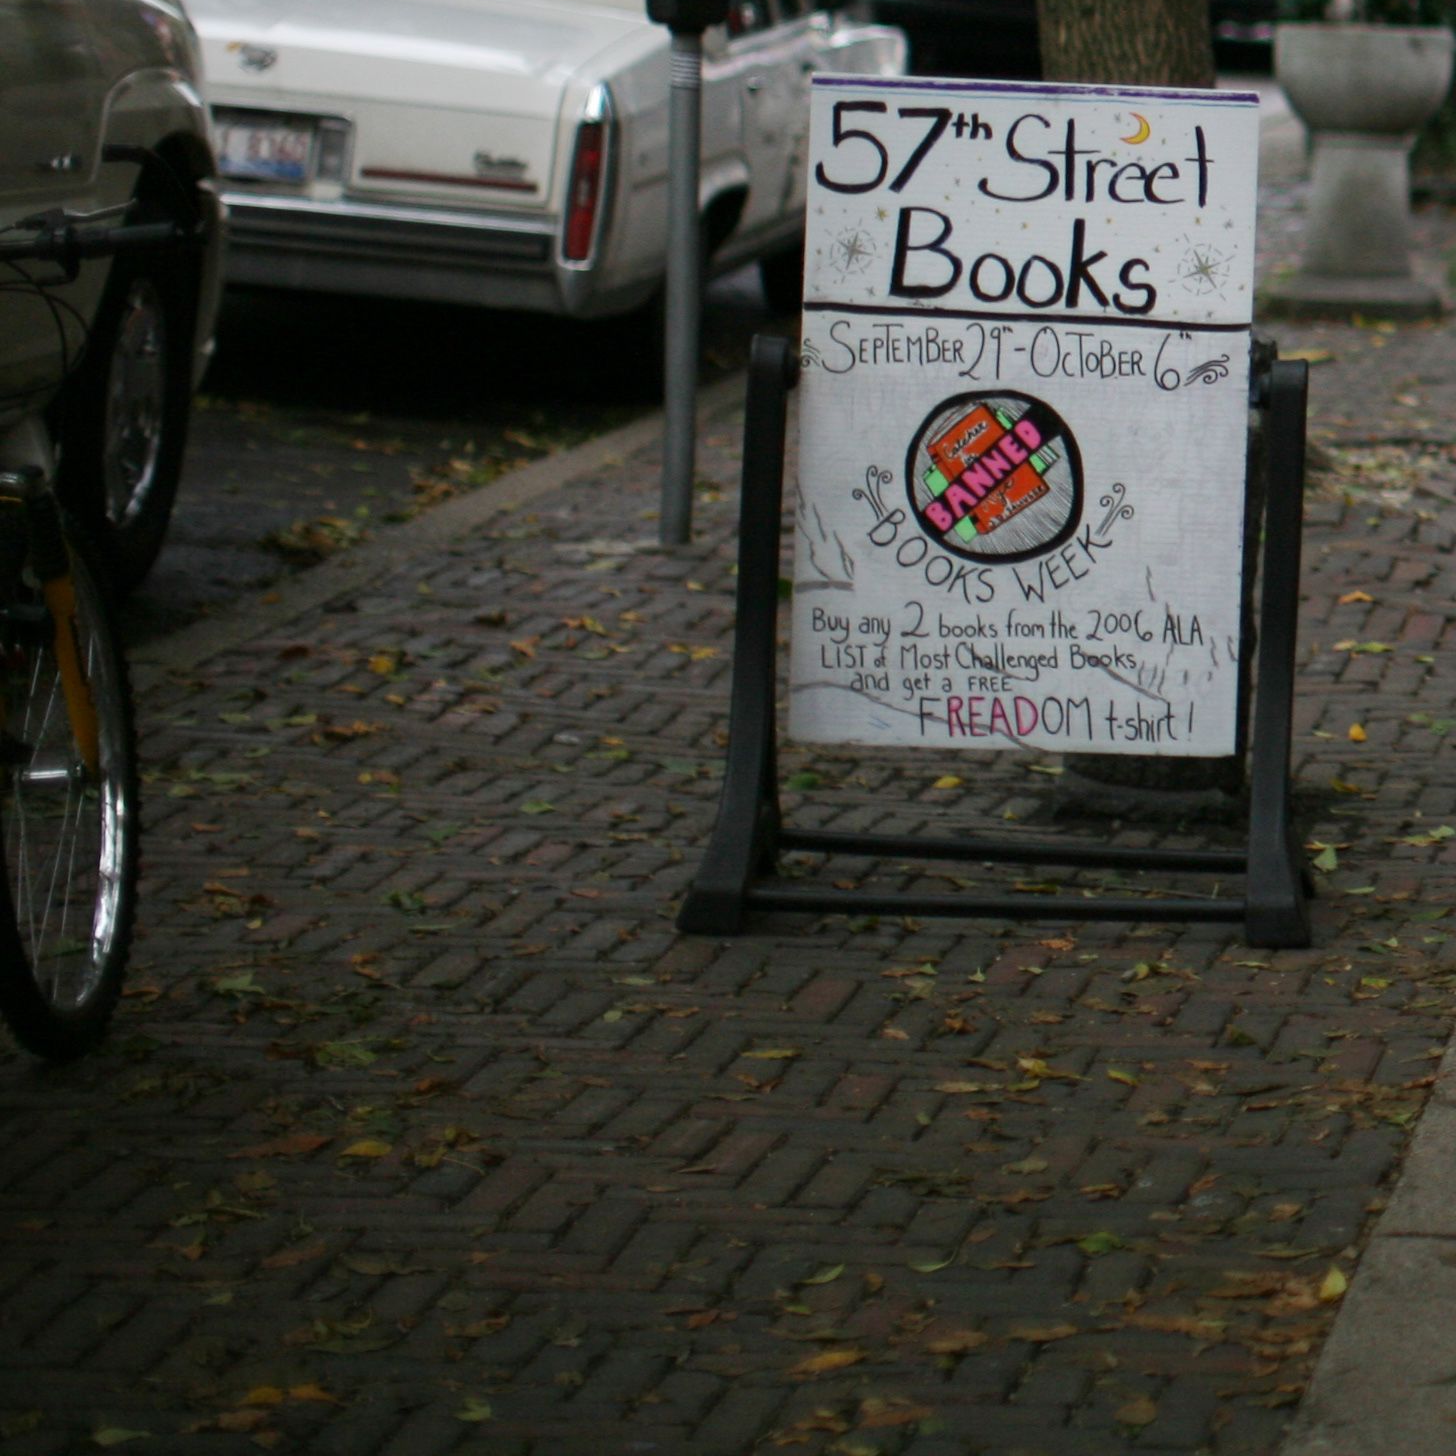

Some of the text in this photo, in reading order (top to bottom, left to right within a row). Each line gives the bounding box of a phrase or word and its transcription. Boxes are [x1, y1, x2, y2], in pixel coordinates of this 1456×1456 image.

[814, 100, 1215, 209] 57th Street
[888, 206, 1157, 315] Books
[924, 419, 1042, 533] BANNED
[867, 508, 1113, 605] BOOKS WEEK
[812, 600, 1204, 647] Buy any 2 books from the 2006 ALA
[821, 641, 1137, 682] LIST of Most Challenged Books
[850, 672, 1013, 701] and get a FREE
[919, 695, 1093, 741] FREADOM
